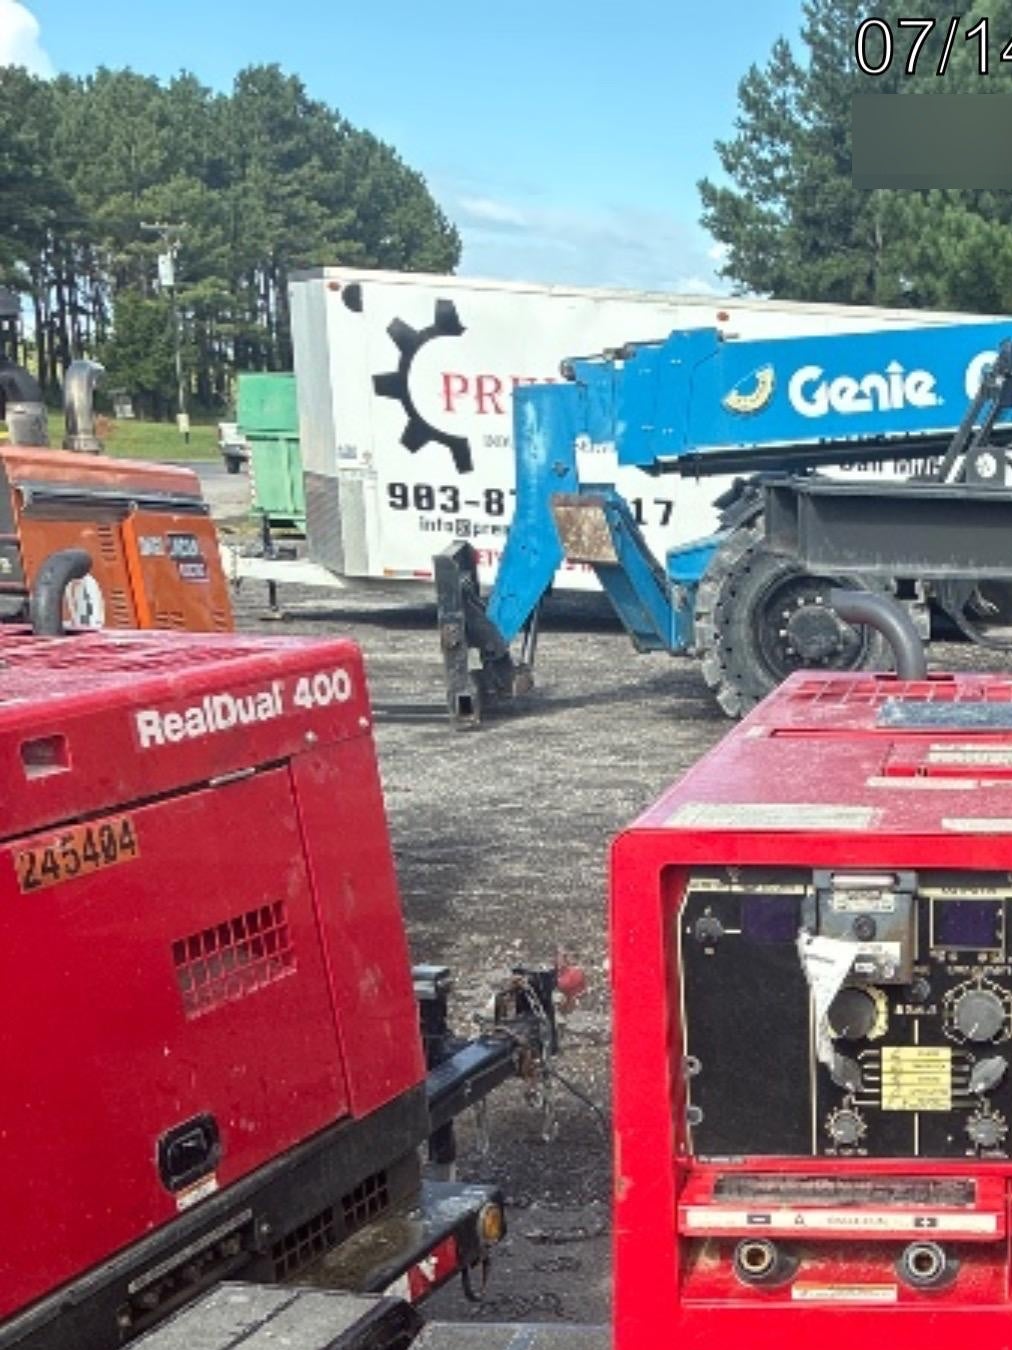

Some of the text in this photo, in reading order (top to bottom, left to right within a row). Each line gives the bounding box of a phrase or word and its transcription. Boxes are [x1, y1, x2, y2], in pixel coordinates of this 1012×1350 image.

[788, 360, 940, 418] Genie
[136, 668, 352, 748] RealDual 400
[21, 820, 137, 892] 245404
